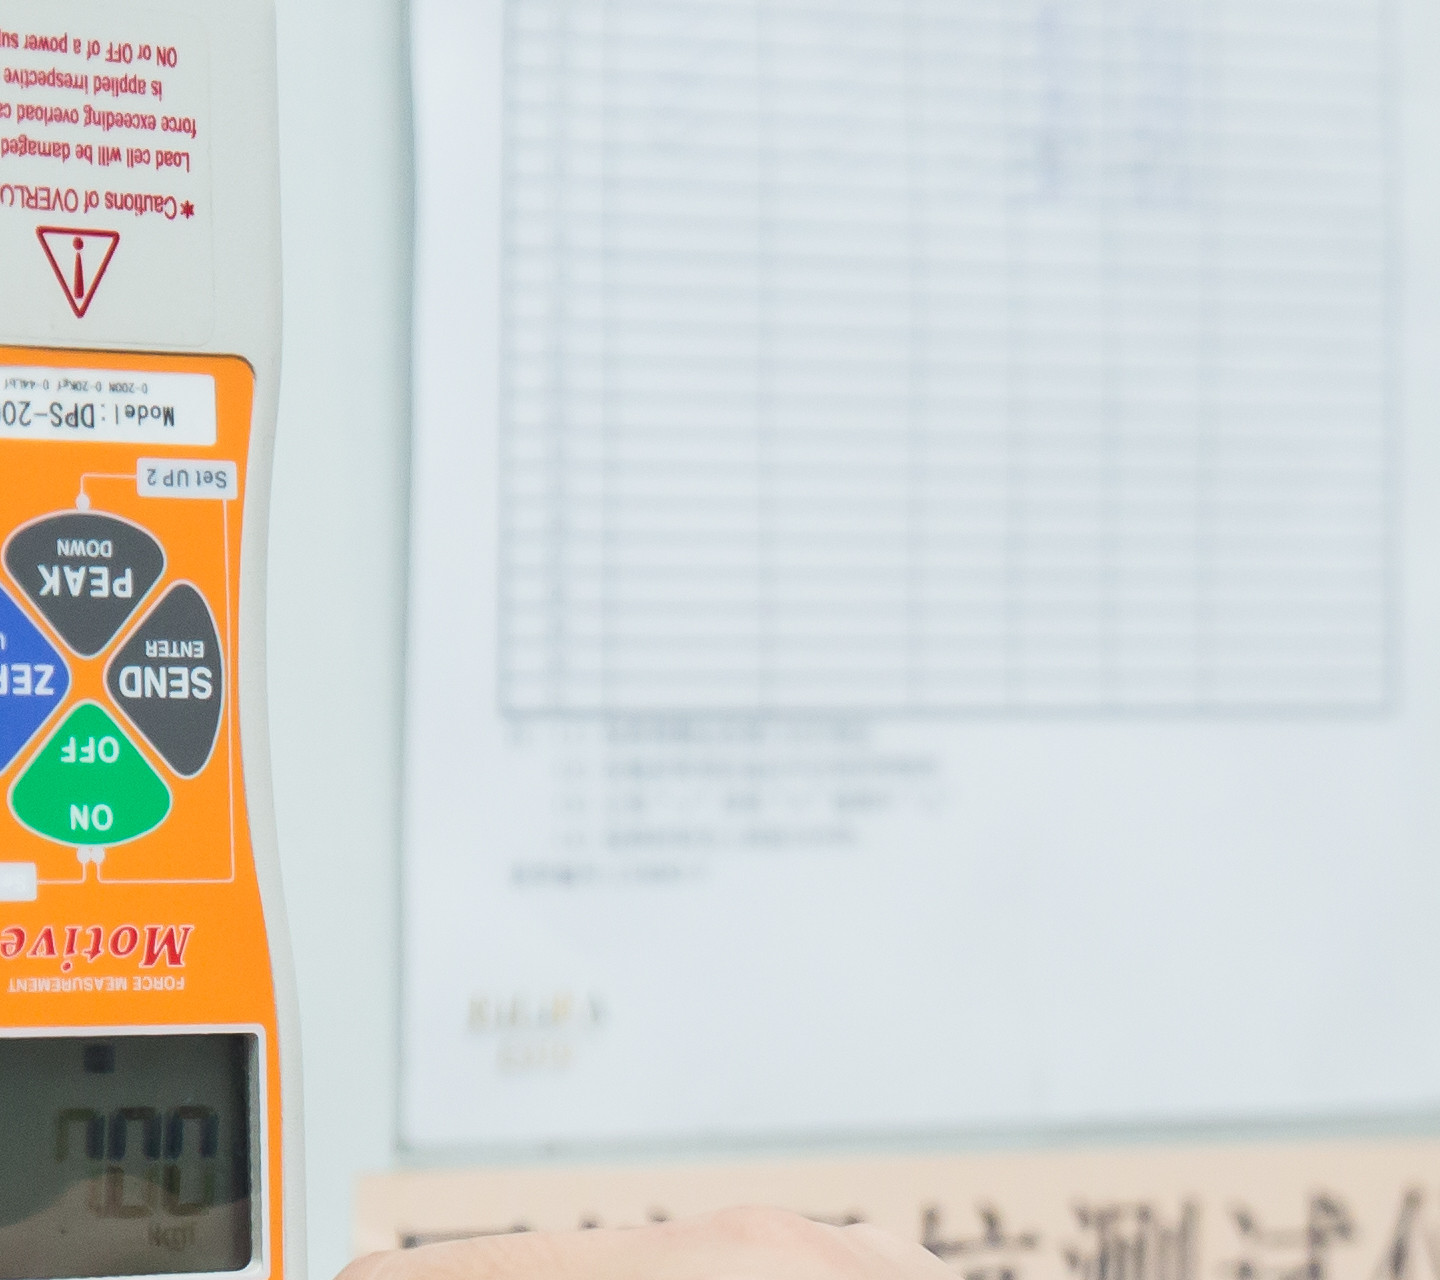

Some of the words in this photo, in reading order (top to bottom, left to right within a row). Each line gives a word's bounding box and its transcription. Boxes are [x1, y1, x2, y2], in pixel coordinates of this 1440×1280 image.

[24, 32, 68, 53] power
[73, 38, 81, 54] a
[87, 40, 100, 60] of
[105, 42, 133, 64] OFF
[137, 44, 151, 60] or
[156, 46, 177, 67] ON
[4, 67, 88, 94] irrespective
[94, 73, 146, 97] applied
[151, 80, 162, 101] is
[17, 104, 78, 126] overload
[84, 104, 156, 131] exceeding
[161, 116, 196, 138] force
[1, 134, 70, 162] damaged
[76, 144, 92, 165] be
[98, 145, 121, 166] will
[126, 148, 150, 168] cell
[156, 150, 190, 172] Load
[84, 190, 99, 214] of
[147, 468, 156, 486] 2
[163, 469, 188, 488] UP
[196, 469, 227, 489] Set
[57, 538, 112, 557] DOWN
[38, 564, 133, 598] PEAK
[146, 640, 204, 658] ENTER
[119, 665, 213, 698] SEND
[60, 736, 120, 764] OFF
[70, 804, 114, 831] ON
[7, 978, 128, 993] MEASUREMENT
[133, 976, 185, 991] FORCE
